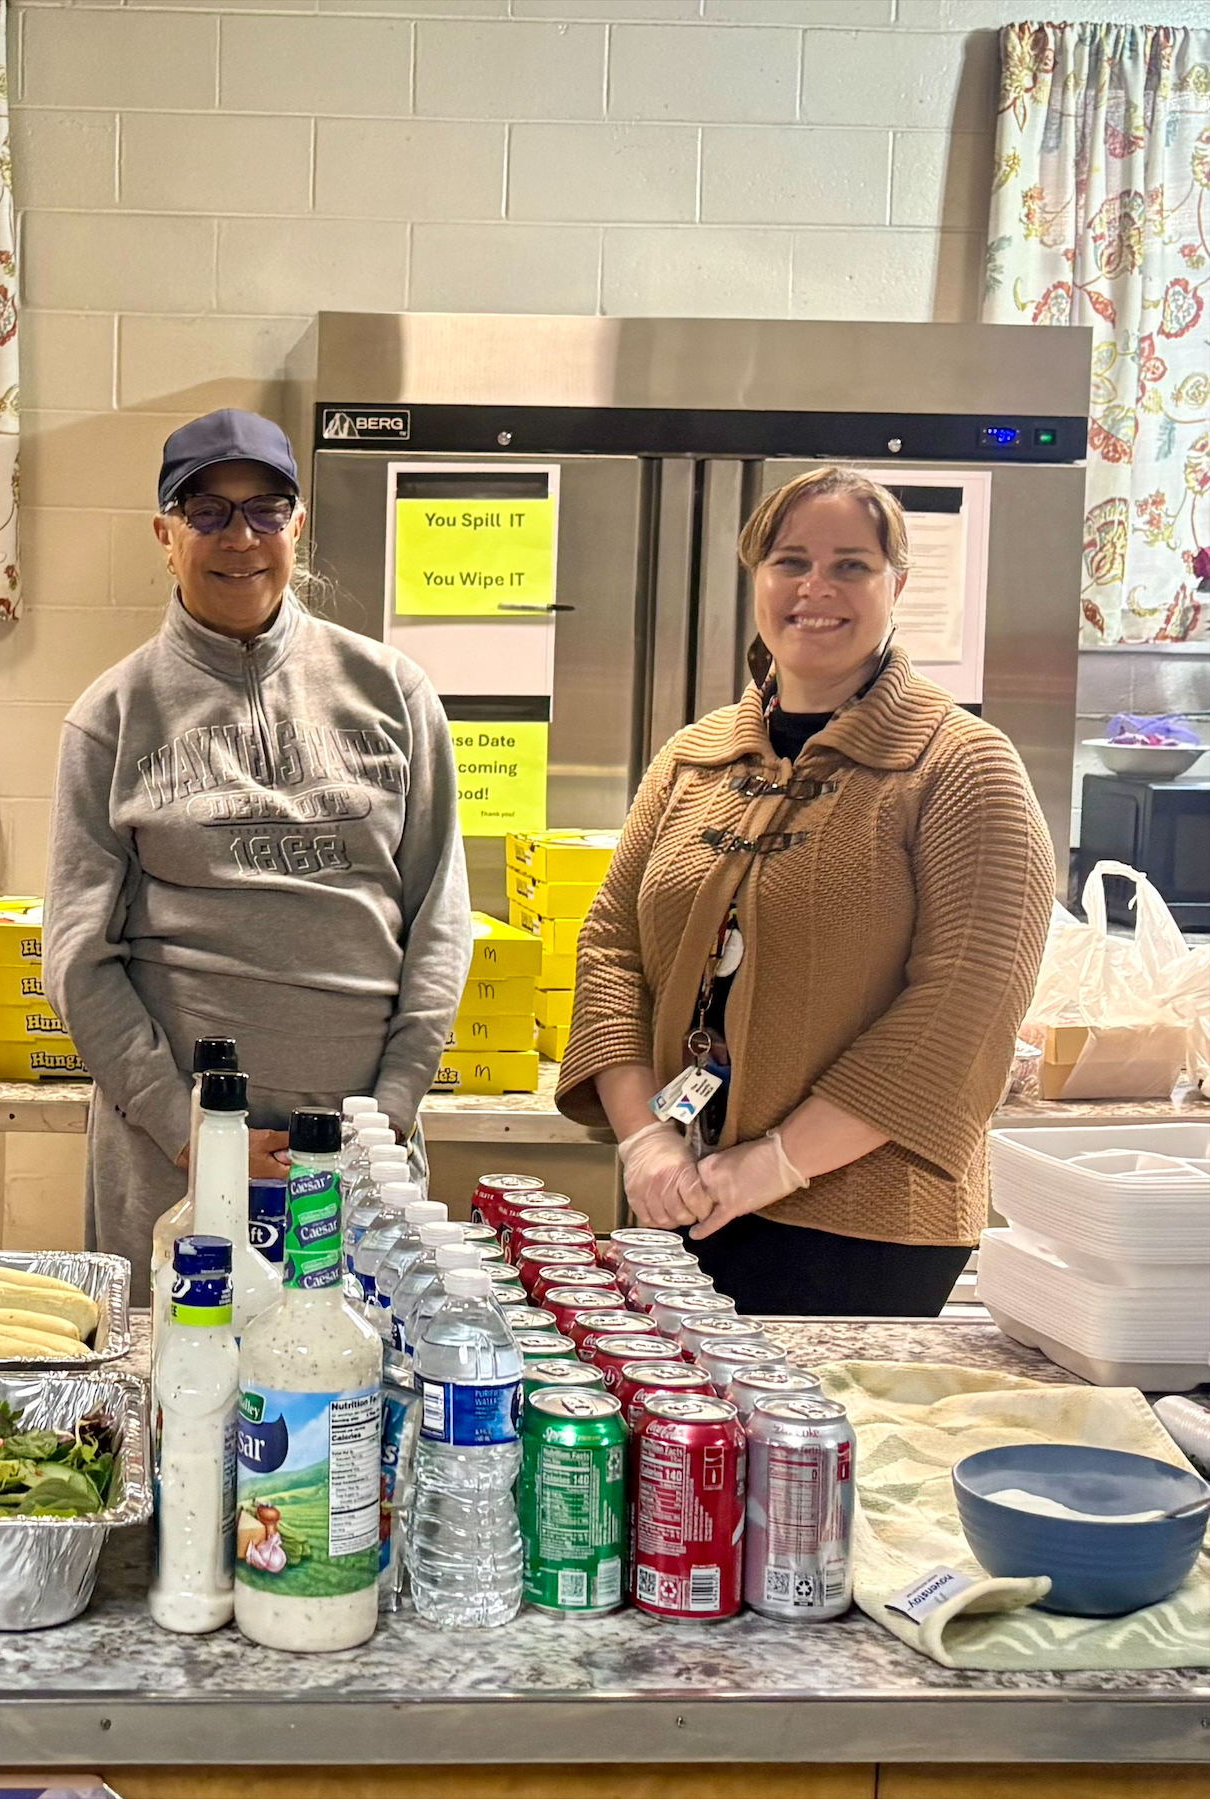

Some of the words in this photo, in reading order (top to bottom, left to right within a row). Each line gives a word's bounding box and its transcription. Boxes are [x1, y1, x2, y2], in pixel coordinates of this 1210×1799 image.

[356, 417, 404, 430] BERG
[425, 513, 456, 527] You
[461, 513, 501, 530] Spill
[509, 513, 525, 527] IT
[423, 571, 454, 586] You
[459, 572, 504, 589] Wipe
[509, 572, 525, 586] IT
[478, 733, 516, 747] Date
[137, 722, 276, 810] WAYNE
[273, 719, 407, 794] STATE
[209, 790, 350, 820] DETOIT
[230, 835, 352, 877] 1868
[26, 1014, 68, 1034] Hun
[30, 1051, 88, 1072] Hungr
[289, 1175, 327, 1197] Caesar
[300, 1219, 339, 1242] Caesar
[303, 1268, 340, 1289] Caesar
[331, 1397, 368, 1411] Nutrition
[331, 1432, 361, 1442] Calories
[573, 1474, 590, 1486] 140
[665, 1469, 683, 1482] 140
